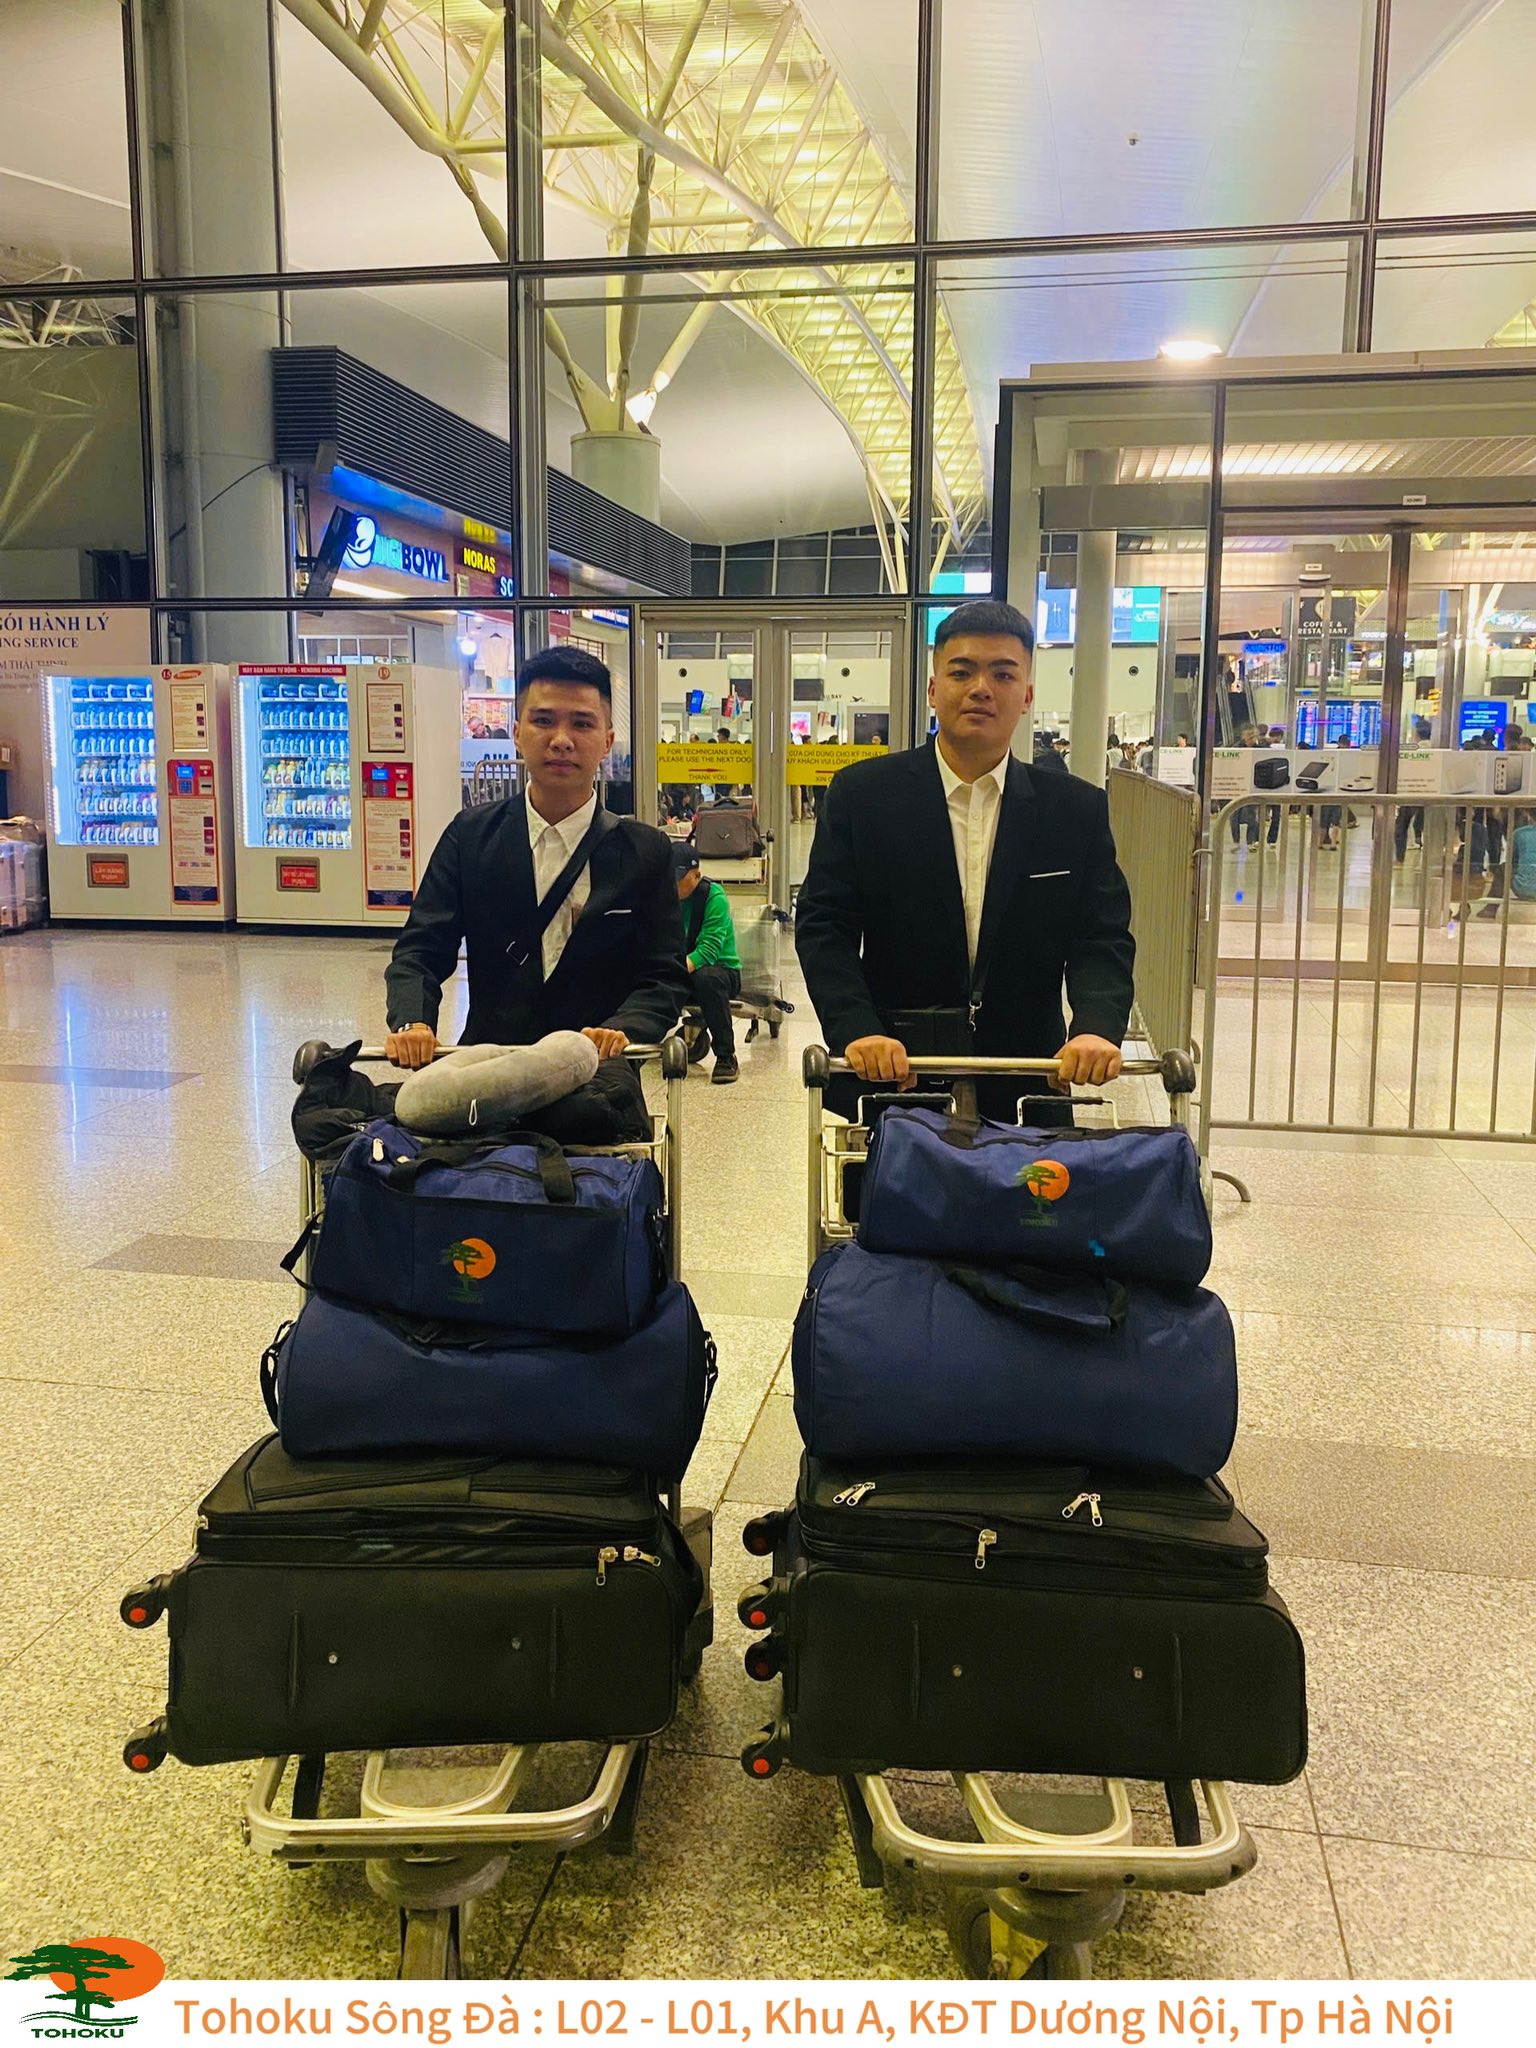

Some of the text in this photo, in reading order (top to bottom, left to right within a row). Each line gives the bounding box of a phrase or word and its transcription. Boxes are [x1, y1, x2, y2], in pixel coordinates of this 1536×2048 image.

[402, 542, 449, 582] BOWL
[463, 547, 496, 574] NORAS
[0, 612, 109, 631] ÓI HÀNH LÝ
[1297, 627, 1348, 635] RESTARANT
[24, 637, 79, 648] SERVICE
